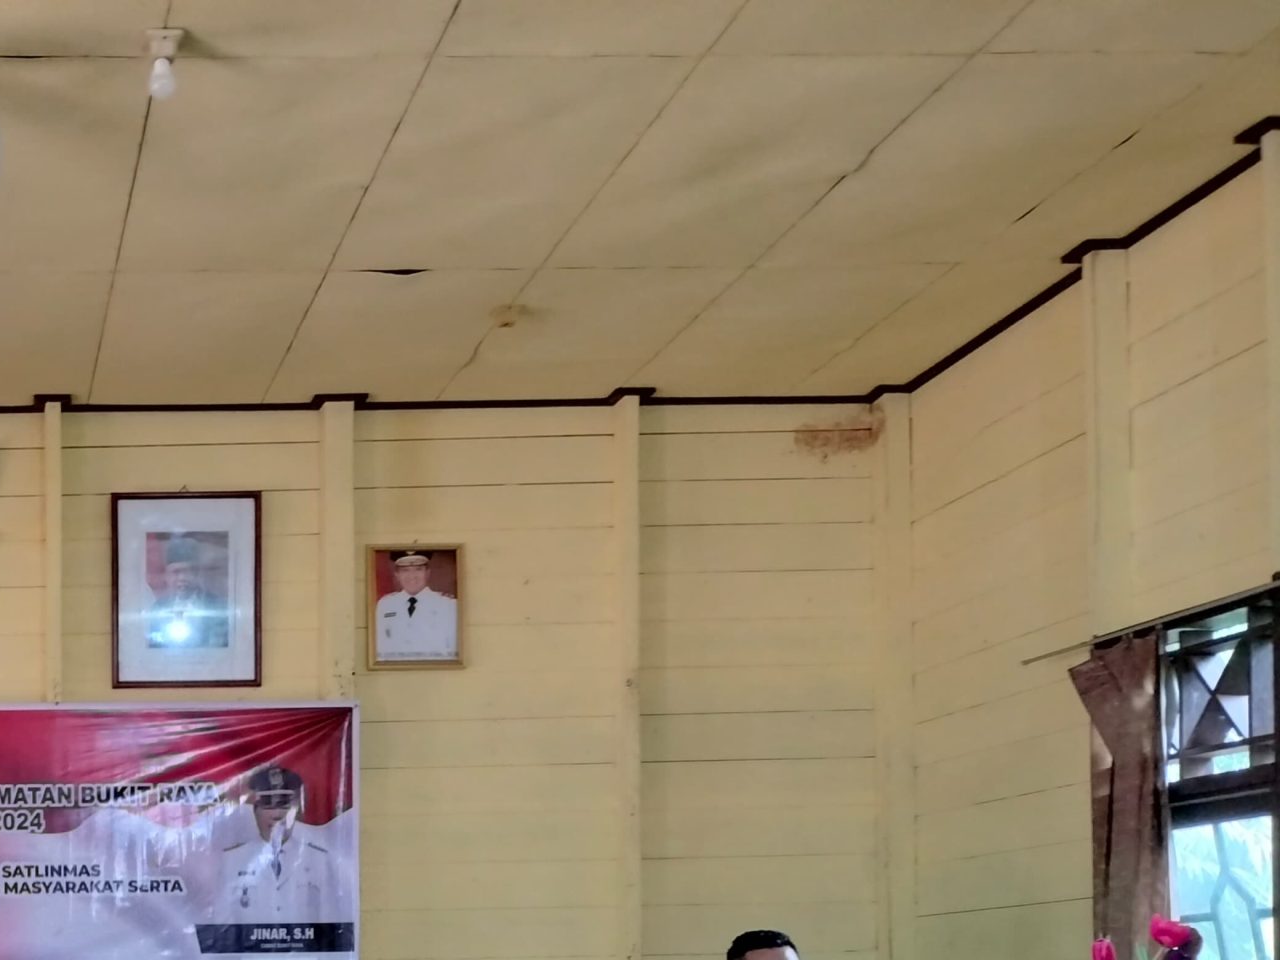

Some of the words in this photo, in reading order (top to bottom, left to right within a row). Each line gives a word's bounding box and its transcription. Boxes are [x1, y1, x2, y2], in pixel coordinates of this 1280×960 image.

[81, 785, 150, 804] BUKIT
[1, 864, 101, 878] SATLINMAS
[4, 880, 122, 894] MASYARAKAT
[128, 880, 183, 893] SERTA
[250, 928, 291, 942] JINAR,
[293, 928, 315, 940] S.H
